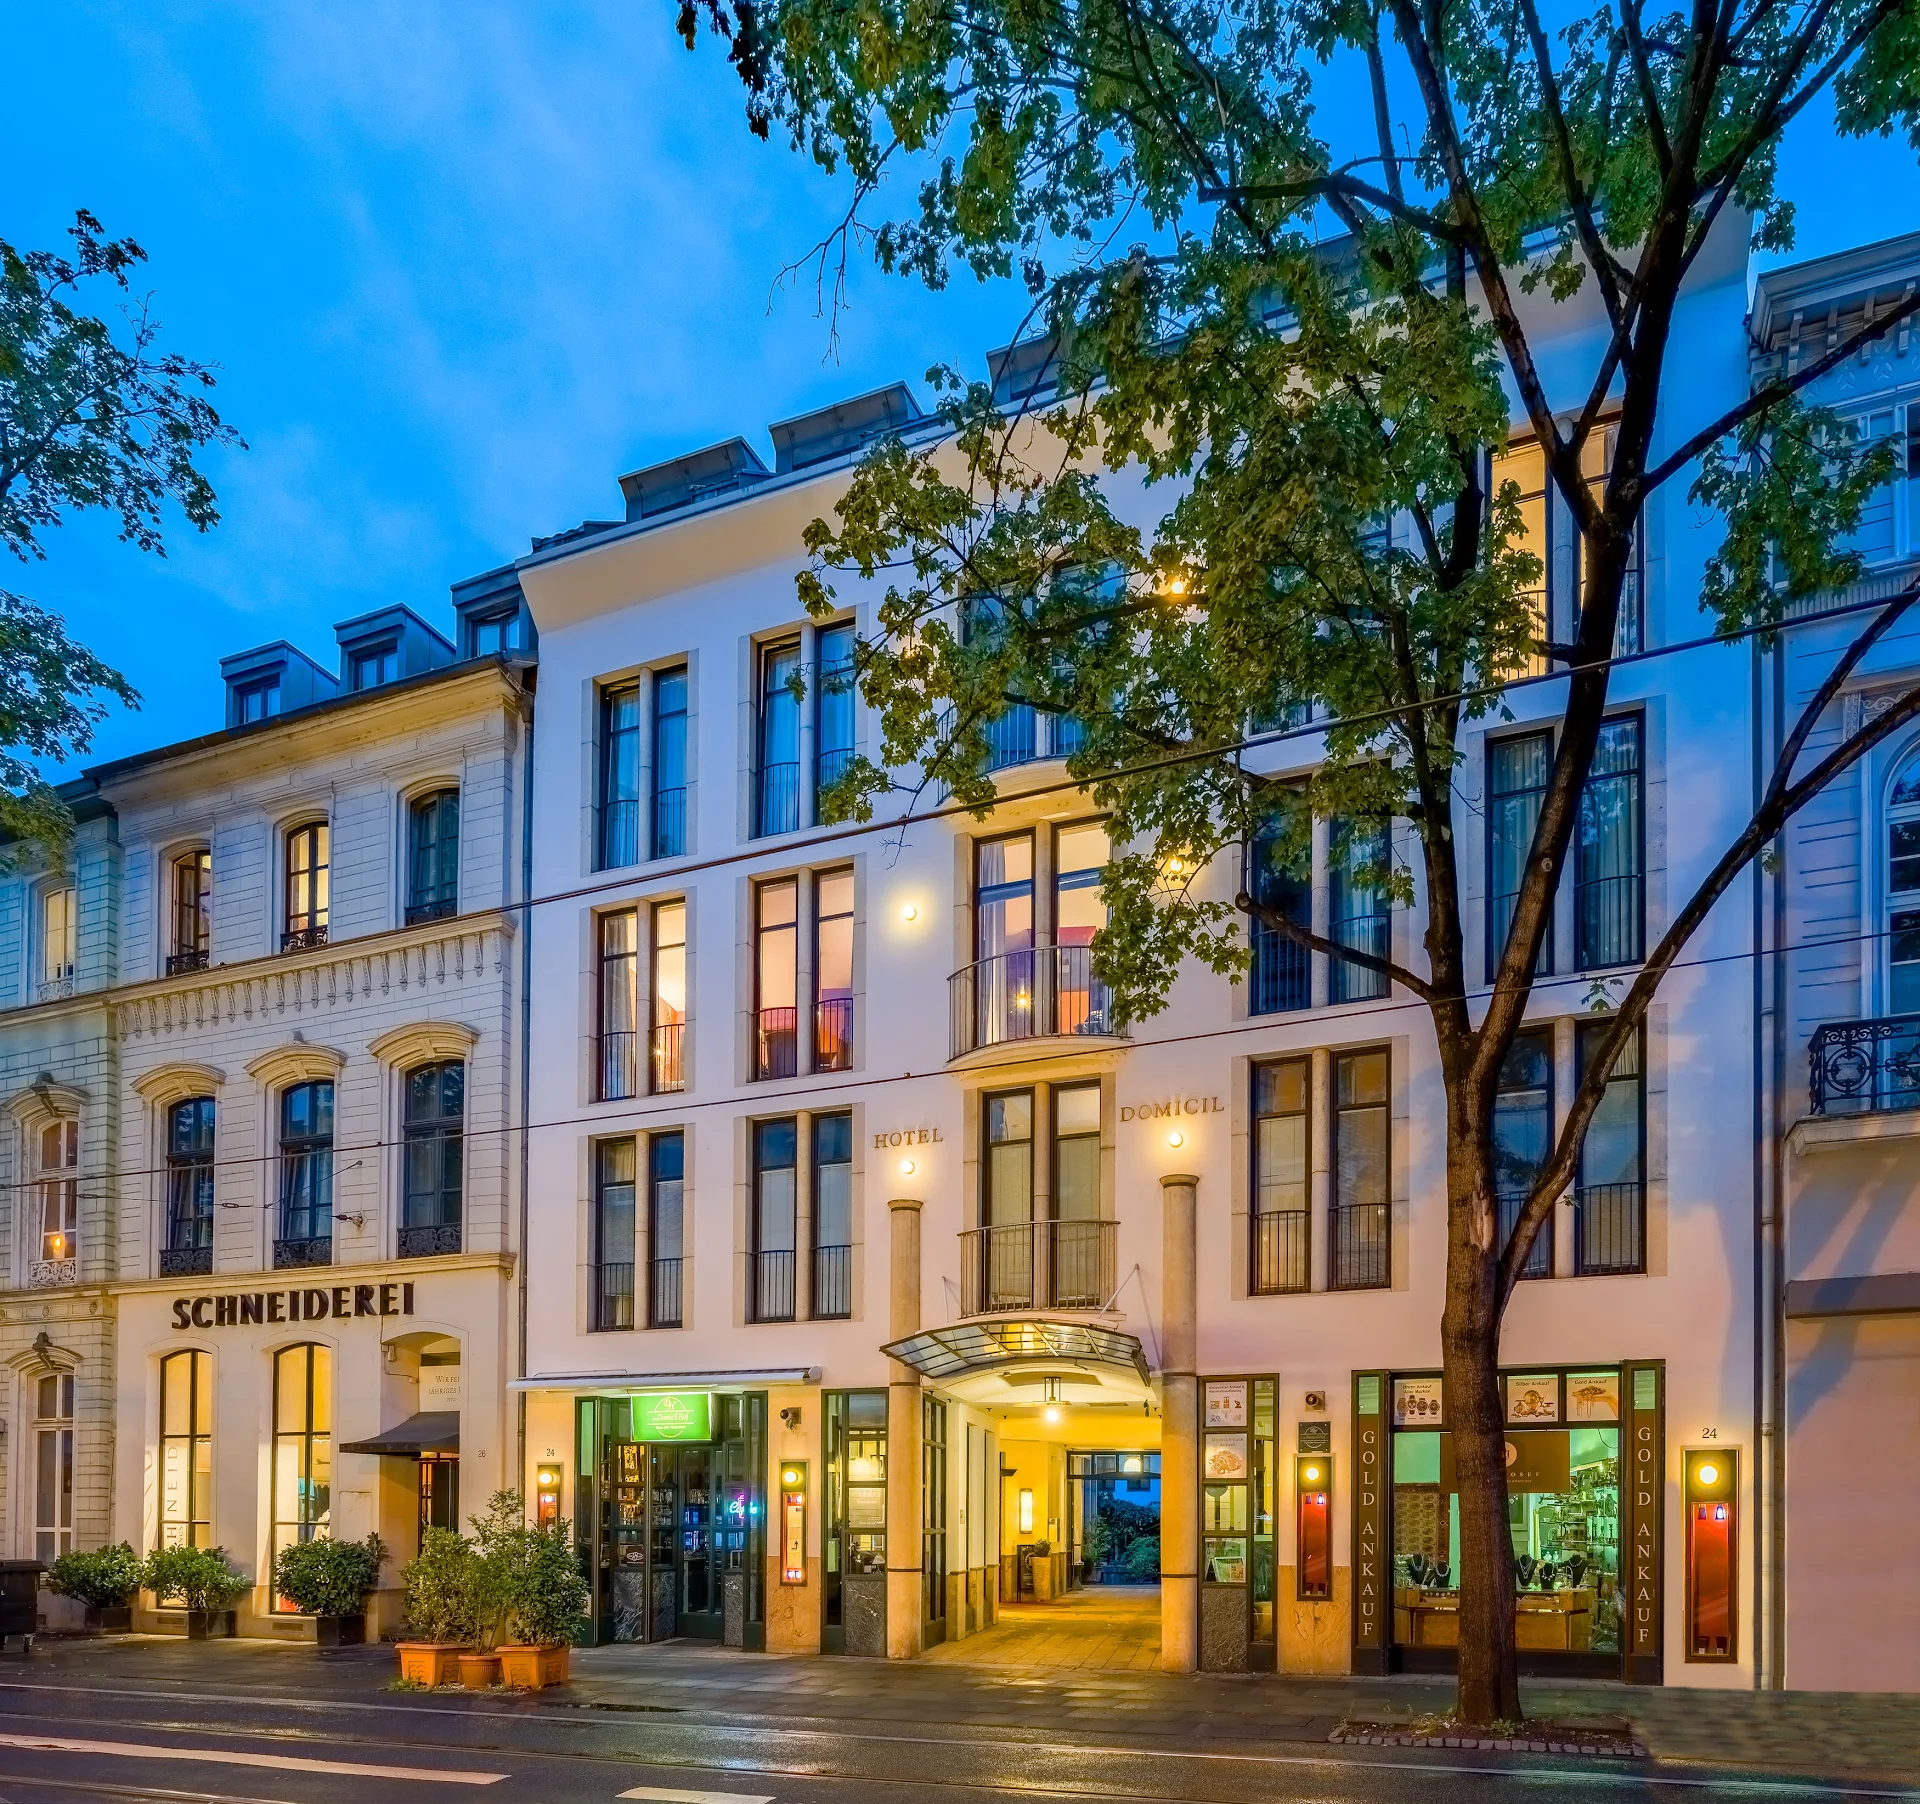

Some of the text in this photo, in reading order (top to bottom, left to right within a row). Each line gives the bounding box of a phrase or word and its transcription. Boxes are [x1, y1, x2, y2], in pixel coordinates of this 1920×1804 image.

[1119, 1096, 1225, 1122] DOMICIL
[874, 1128, 943, 1149] HOTEL
[171, 1282, 414, 1330] SCHNEIDEREI
[1702, 1427, 1718, 1439] 24
[477, 1449, 486, 1458] 26
[546, 1447, 555, 1457] 24
[1362, 1430, 1375, 1636] GOLD ANKAUF
[1637, 1427, 1651, 1643] GOLD ANKAUF
